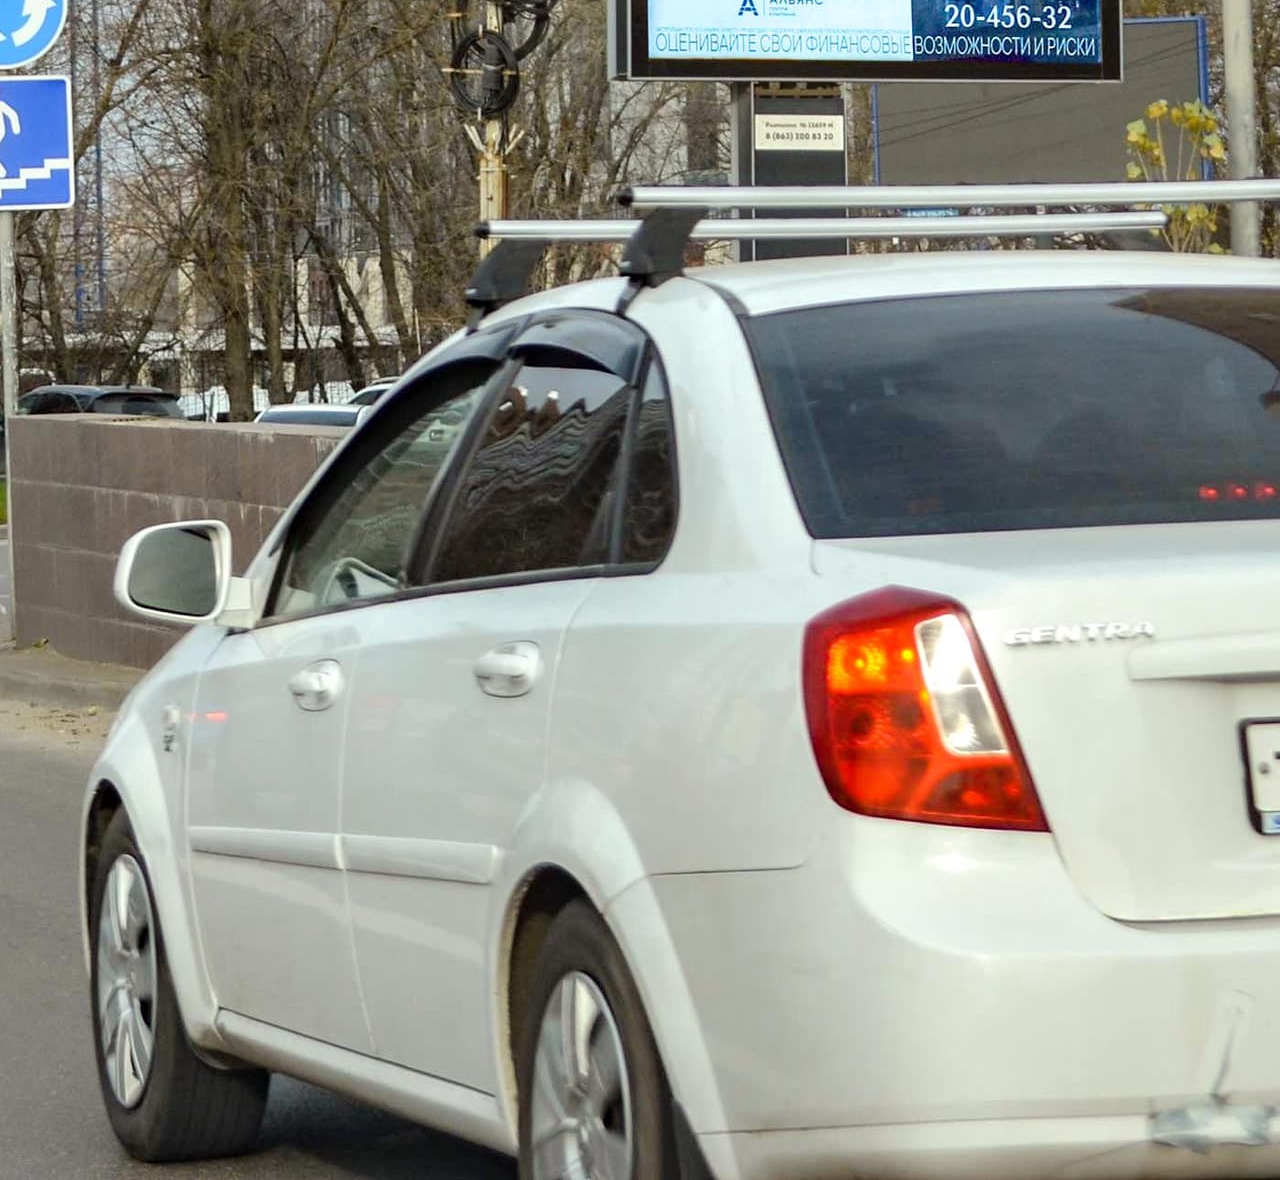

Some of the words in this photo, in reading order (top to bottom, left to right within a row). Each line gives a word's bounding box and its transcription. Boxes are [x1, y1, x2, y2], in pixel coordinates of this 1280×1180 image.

[944, 4, 1073, 29] 20-456-32
[655, 32, 757, 53] ОЦЕНИВАЙТЕ
[760, 33, 803, 53] СВОИ
[806, 35, 912, 54] ФИНАНСОВЫЕ
[914, 35, 1031, 56] ВОЗМОЖНОСТИ
[1034, 37, 1045, 55] И
[1047, 37, 1096, 56] РИСКИ
[1003, 621, 1155, 646] GENTRA
